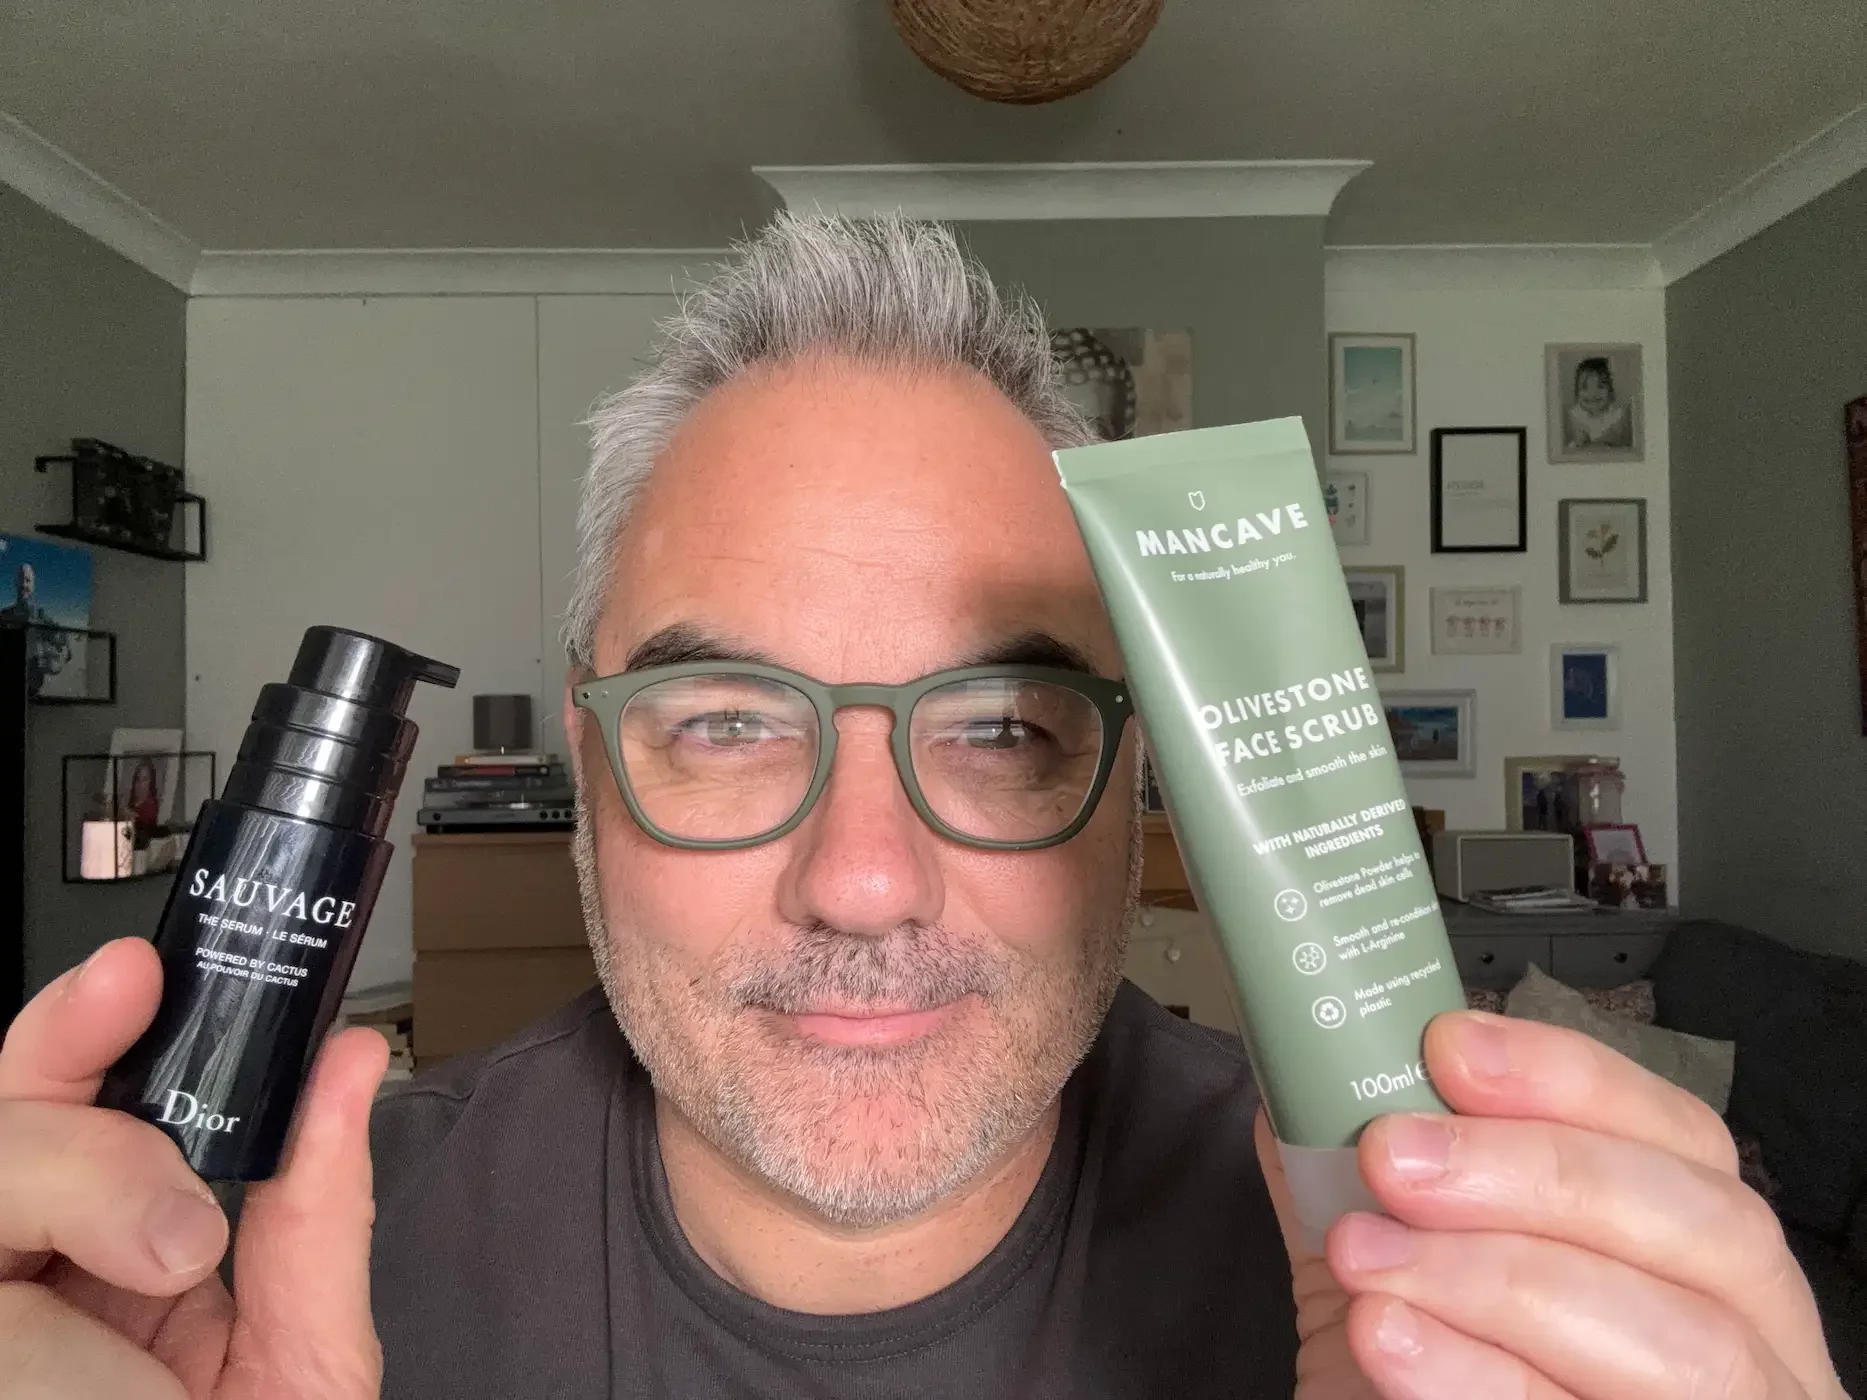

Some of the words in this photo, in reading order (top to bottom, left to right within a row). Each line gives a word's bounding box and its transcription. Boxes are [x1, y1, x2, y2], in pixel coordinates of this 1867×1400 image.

[1135, 503, 1309, 557] MANCAVE
[1171, 571, 1186, 583] For
[1195, 567, 1231, 581] naturally
[1231, 558, 1270, 576] healthy
[1272, 552, 1297, 567] you.
[1198, 667, 1370, 730] OLIVESTONE
[1214, 730, 1282, 768] FACE
[1284, 703, 1379, 750] SCRUB
[1237, 776, 1285, 797] Exfoliate
[1286, 768, 1304, 784] and
[1306, 756, 1348, 778] smooth
[1349, 751, 1367, 765] the
[1369, 744, 1387, 759] skin
[1253, 833, 1292, 856] WITH
[1293, 812, 1358, 848] NATURALLY
[1359, 798, 1406, 824] DERIVED
[1305, 824, 1384, 859] INGREDIENTS
[1313, 872, 1361, 893] Olivestone
[1361, 860, 1394, 877] Powder
[1394, 852, 1414, 867] helps
[1319, 890, 1354, 908] remove
[1354, 879, 1378, 896] dead
[1378, 875, 1396, 888] skin
[1396, 868, 1414, 880] cells
[188, 867, 357, 929] SAUVAGE
[198, 913, 220, 929] THE
[220, 918, 263, 937] SERUM
[272, 930, 287, 942] LE
[290, 932, 328, 949] SÉRUM
[1333, 926, 1370, 947] Smooth
[1371, 918, 1389, 934] and
[1390, 905, 1432, 928] re-condition
[1338, 939, 1360, 961] with
[1361, 931, 1406, 953] L-Arginine
[195, 947, 248, 967] POWERED
[249, 958, 266, 970] BY
[267, 961, 308, 978] CACTUS
[196, 960, 210, 970] AU
[210, 963, 250, 978] POUVOIR
[251, 971, 264, 980] DU
[265, 974, 299, 987] CACTUS
[1354, 981, 1385, 1001] Made
[1385, 971, 1410, 994] using
[1410, 961, 1440, 984] recycled
[1359, 996, 1392, 1018] plastic
[1350, 1063, 1415, 1101] 100ml
[157, 1088, 241, 1133] Dior
